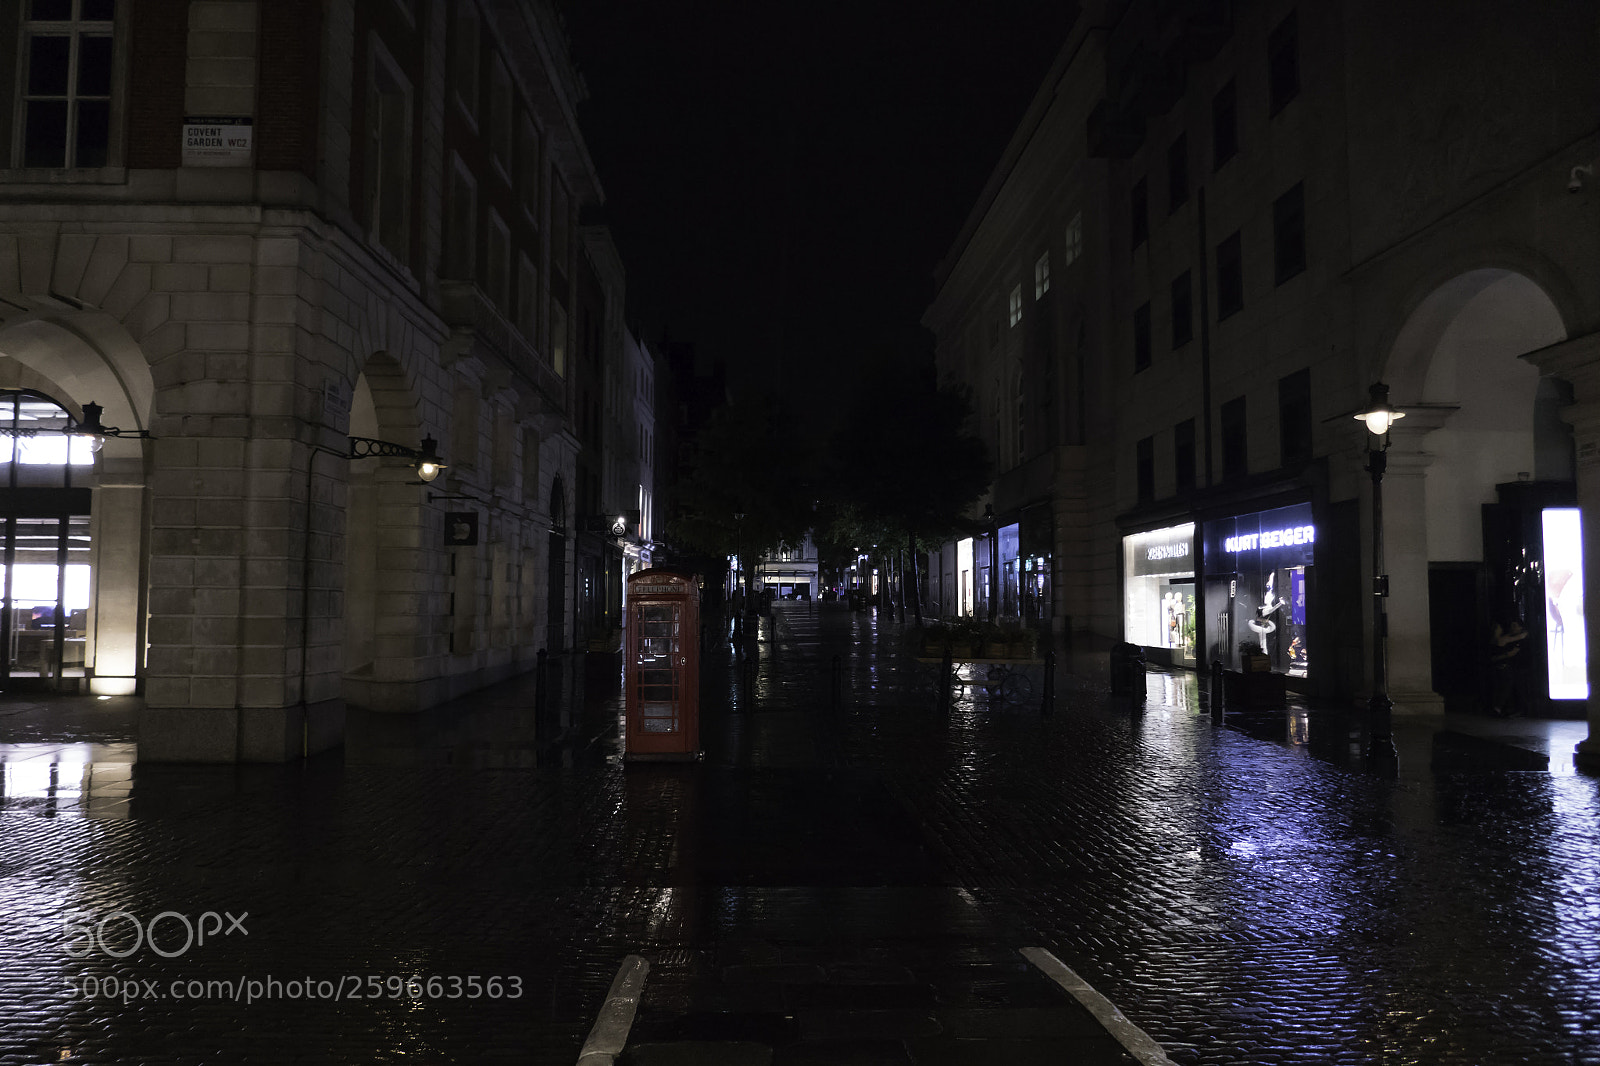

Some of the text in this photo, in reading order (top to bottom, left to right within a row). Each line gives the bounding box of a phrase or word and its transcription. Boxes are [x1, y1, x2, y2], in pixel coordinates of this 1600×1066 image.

[188, 128, 222, 136] COVENT
[188, 138, 248, 148] GARDEN WC2
[1225, 526, 1315, 552] KURT GEIGER
